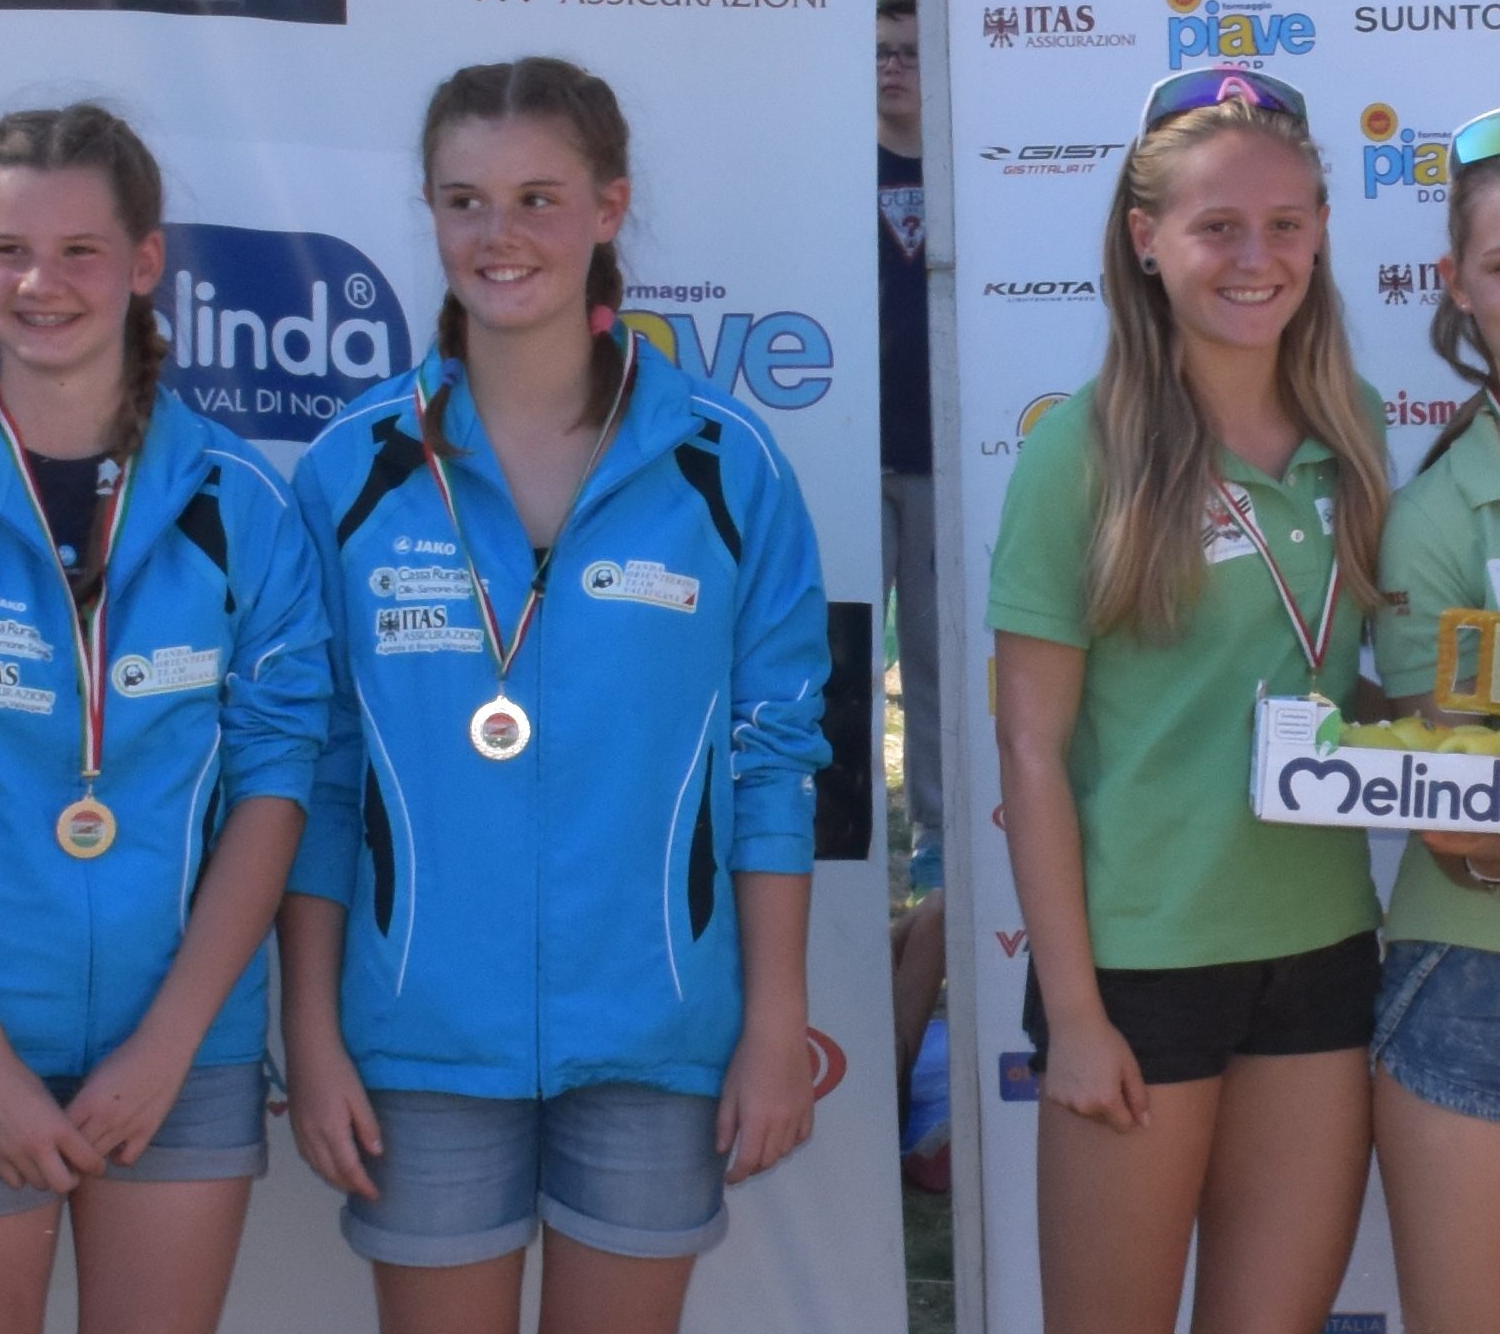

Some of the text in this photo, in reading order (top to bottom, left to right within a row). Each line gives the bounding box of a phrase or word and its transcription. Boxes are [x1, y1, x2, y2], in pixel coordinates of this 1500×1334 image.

[1025, 5, 1096, 34] ITAS
[1026, 34, 1136, 49] ASSICURAZIONI
[1168, 0, 1317, 70] piave
[1018, 144, 1126, 160] GIST
[1364, 128, 1449, 200] pia
[626, 281, 726, 303] rmaggio
[983, 281, 1096, 296] KUOTA
[153, 270, 392, 379] linda
[194, 388, 247, 413] VAL
[257, 388, 282, 413] DI
[1384, 390, 1457, 426] eism
[414, 540, 457, 556] JAKO
[403, 608, 446, 630] ITAS
